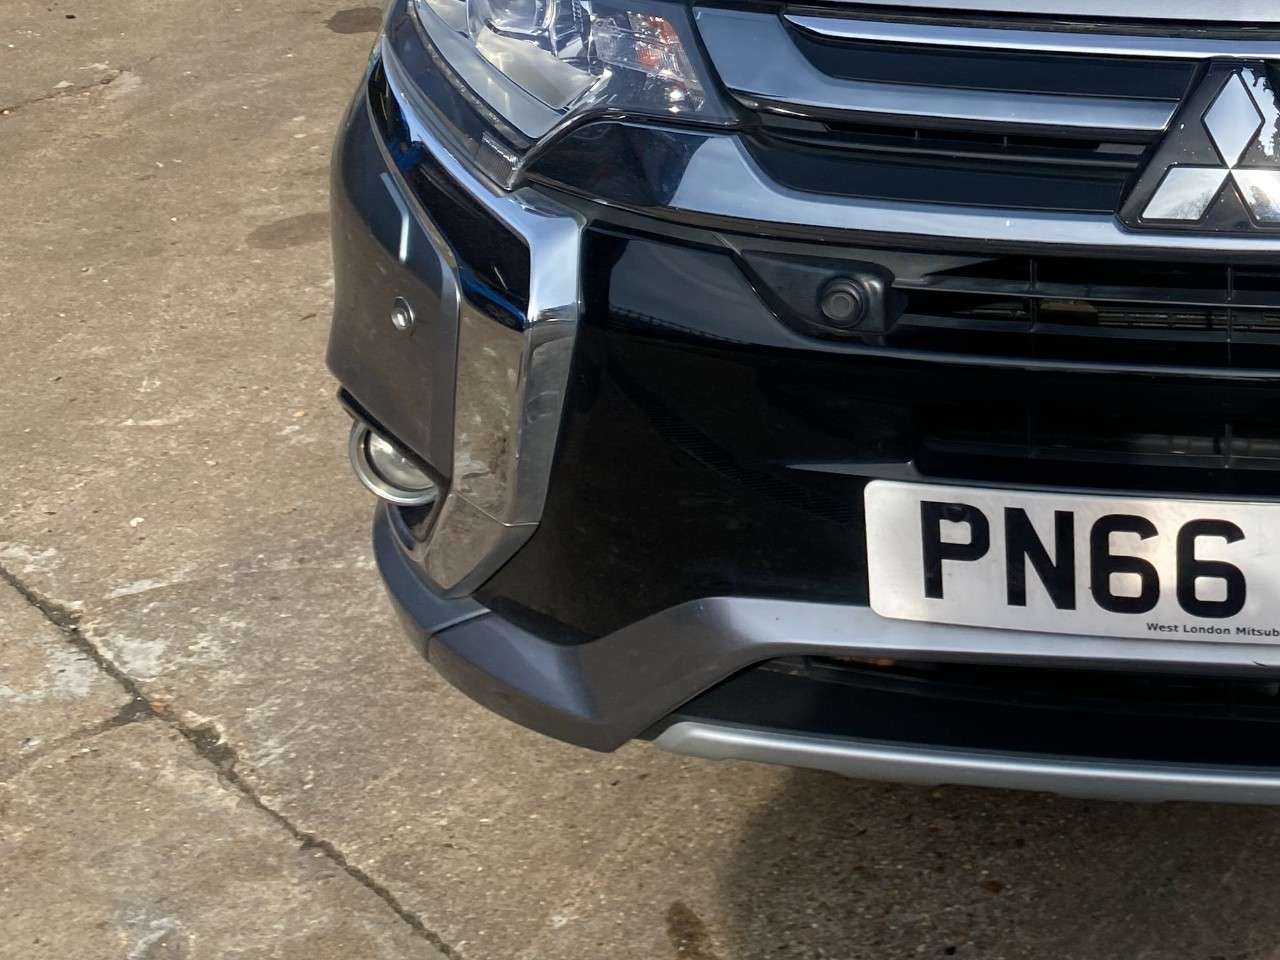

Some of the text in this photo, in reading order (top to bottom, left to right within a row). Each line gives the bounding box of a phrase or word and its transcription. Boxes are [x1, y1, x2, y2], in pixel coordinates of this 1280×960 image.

[920, 500, 1247, 618] PN66
[1146, 622, 1179, 633] West
[1183, 624, 1231, 636] London
